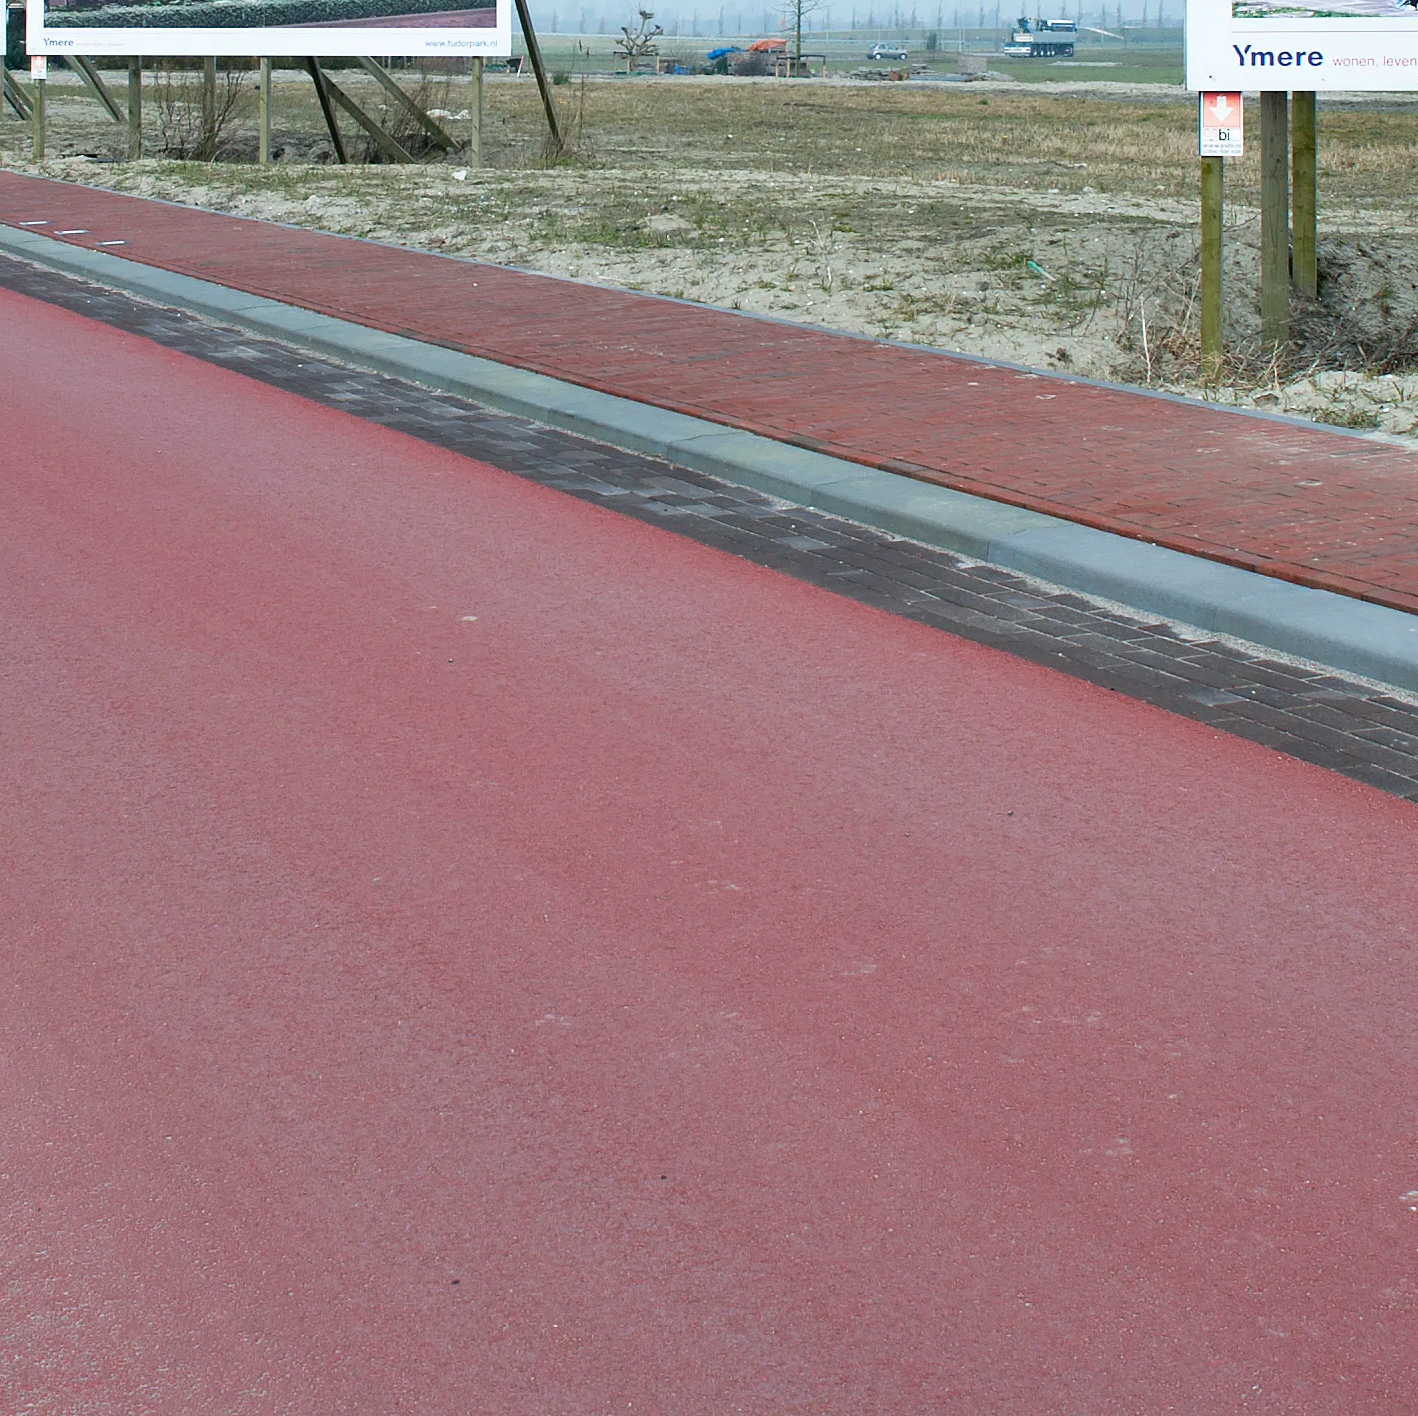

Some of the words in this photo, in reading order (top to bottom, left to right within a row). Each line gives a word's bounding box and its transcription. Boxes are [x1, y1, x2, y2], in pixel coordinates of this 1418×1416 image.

[43, 37, 74, 47] Ymere
[424, 39, 498, 48] www.tudorpark.nl
[1232, 44, 1324, 67] Ymere
[1333, 55, 1378, 70] wonen,
